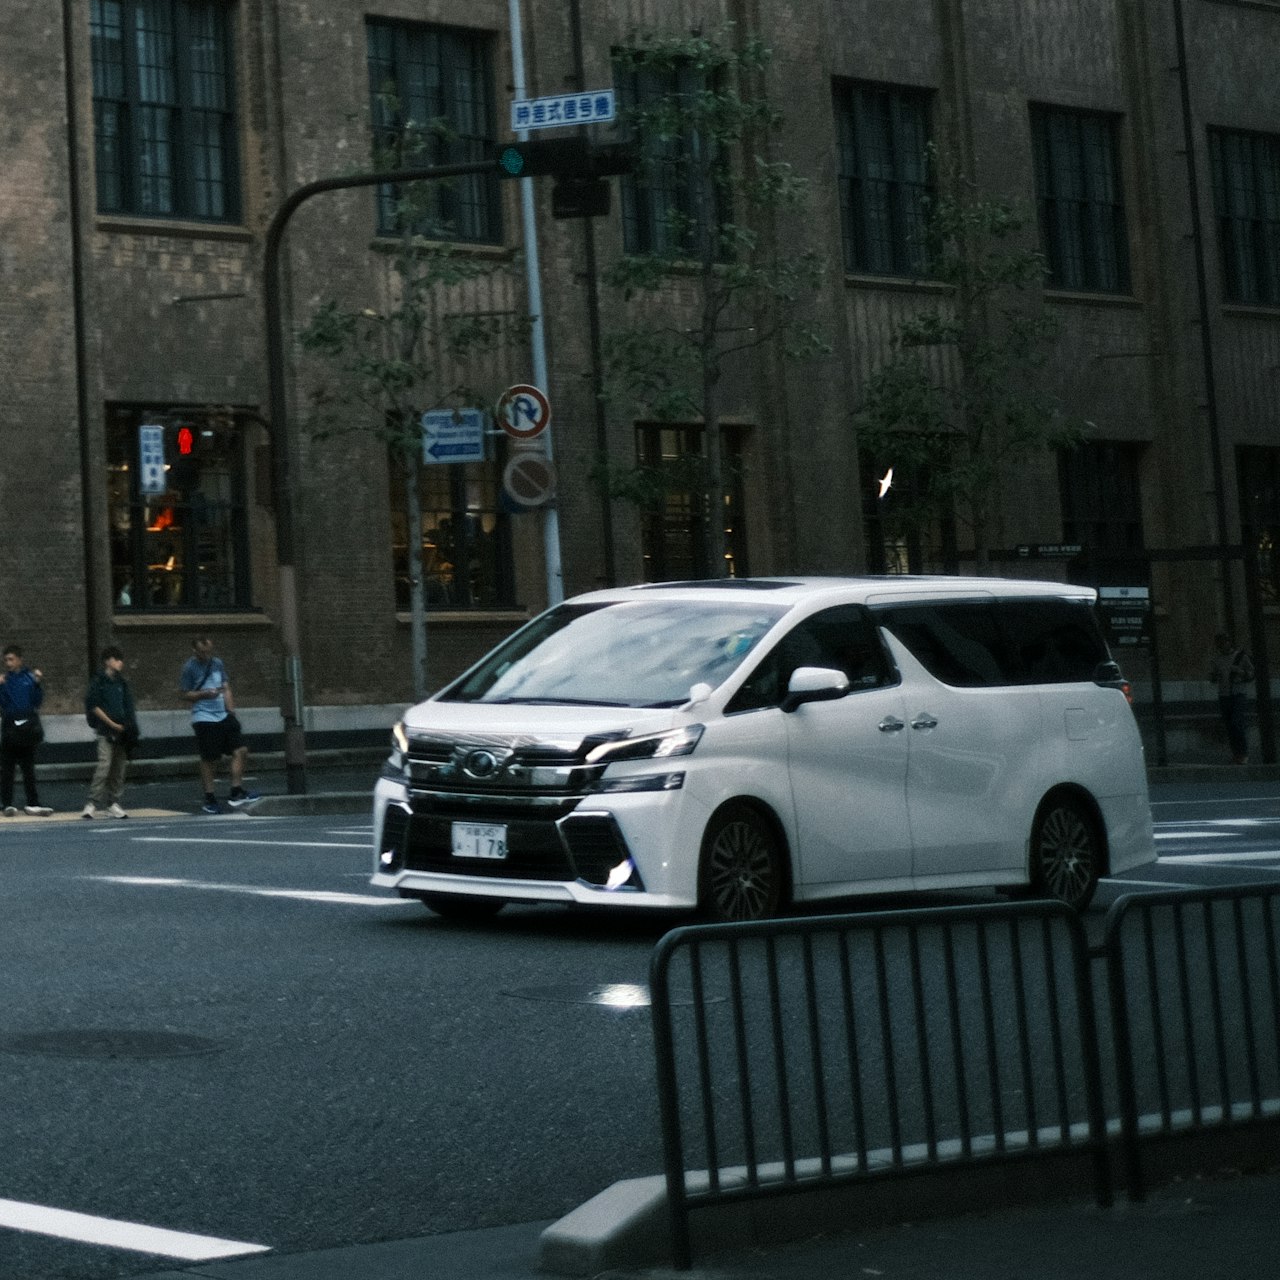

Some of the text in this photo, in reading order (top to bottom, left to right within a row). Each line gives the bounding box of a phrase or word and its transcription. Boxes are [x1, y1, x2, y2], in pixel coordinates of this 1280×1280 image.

[516, 95, 609, 125] 時差式信号機
